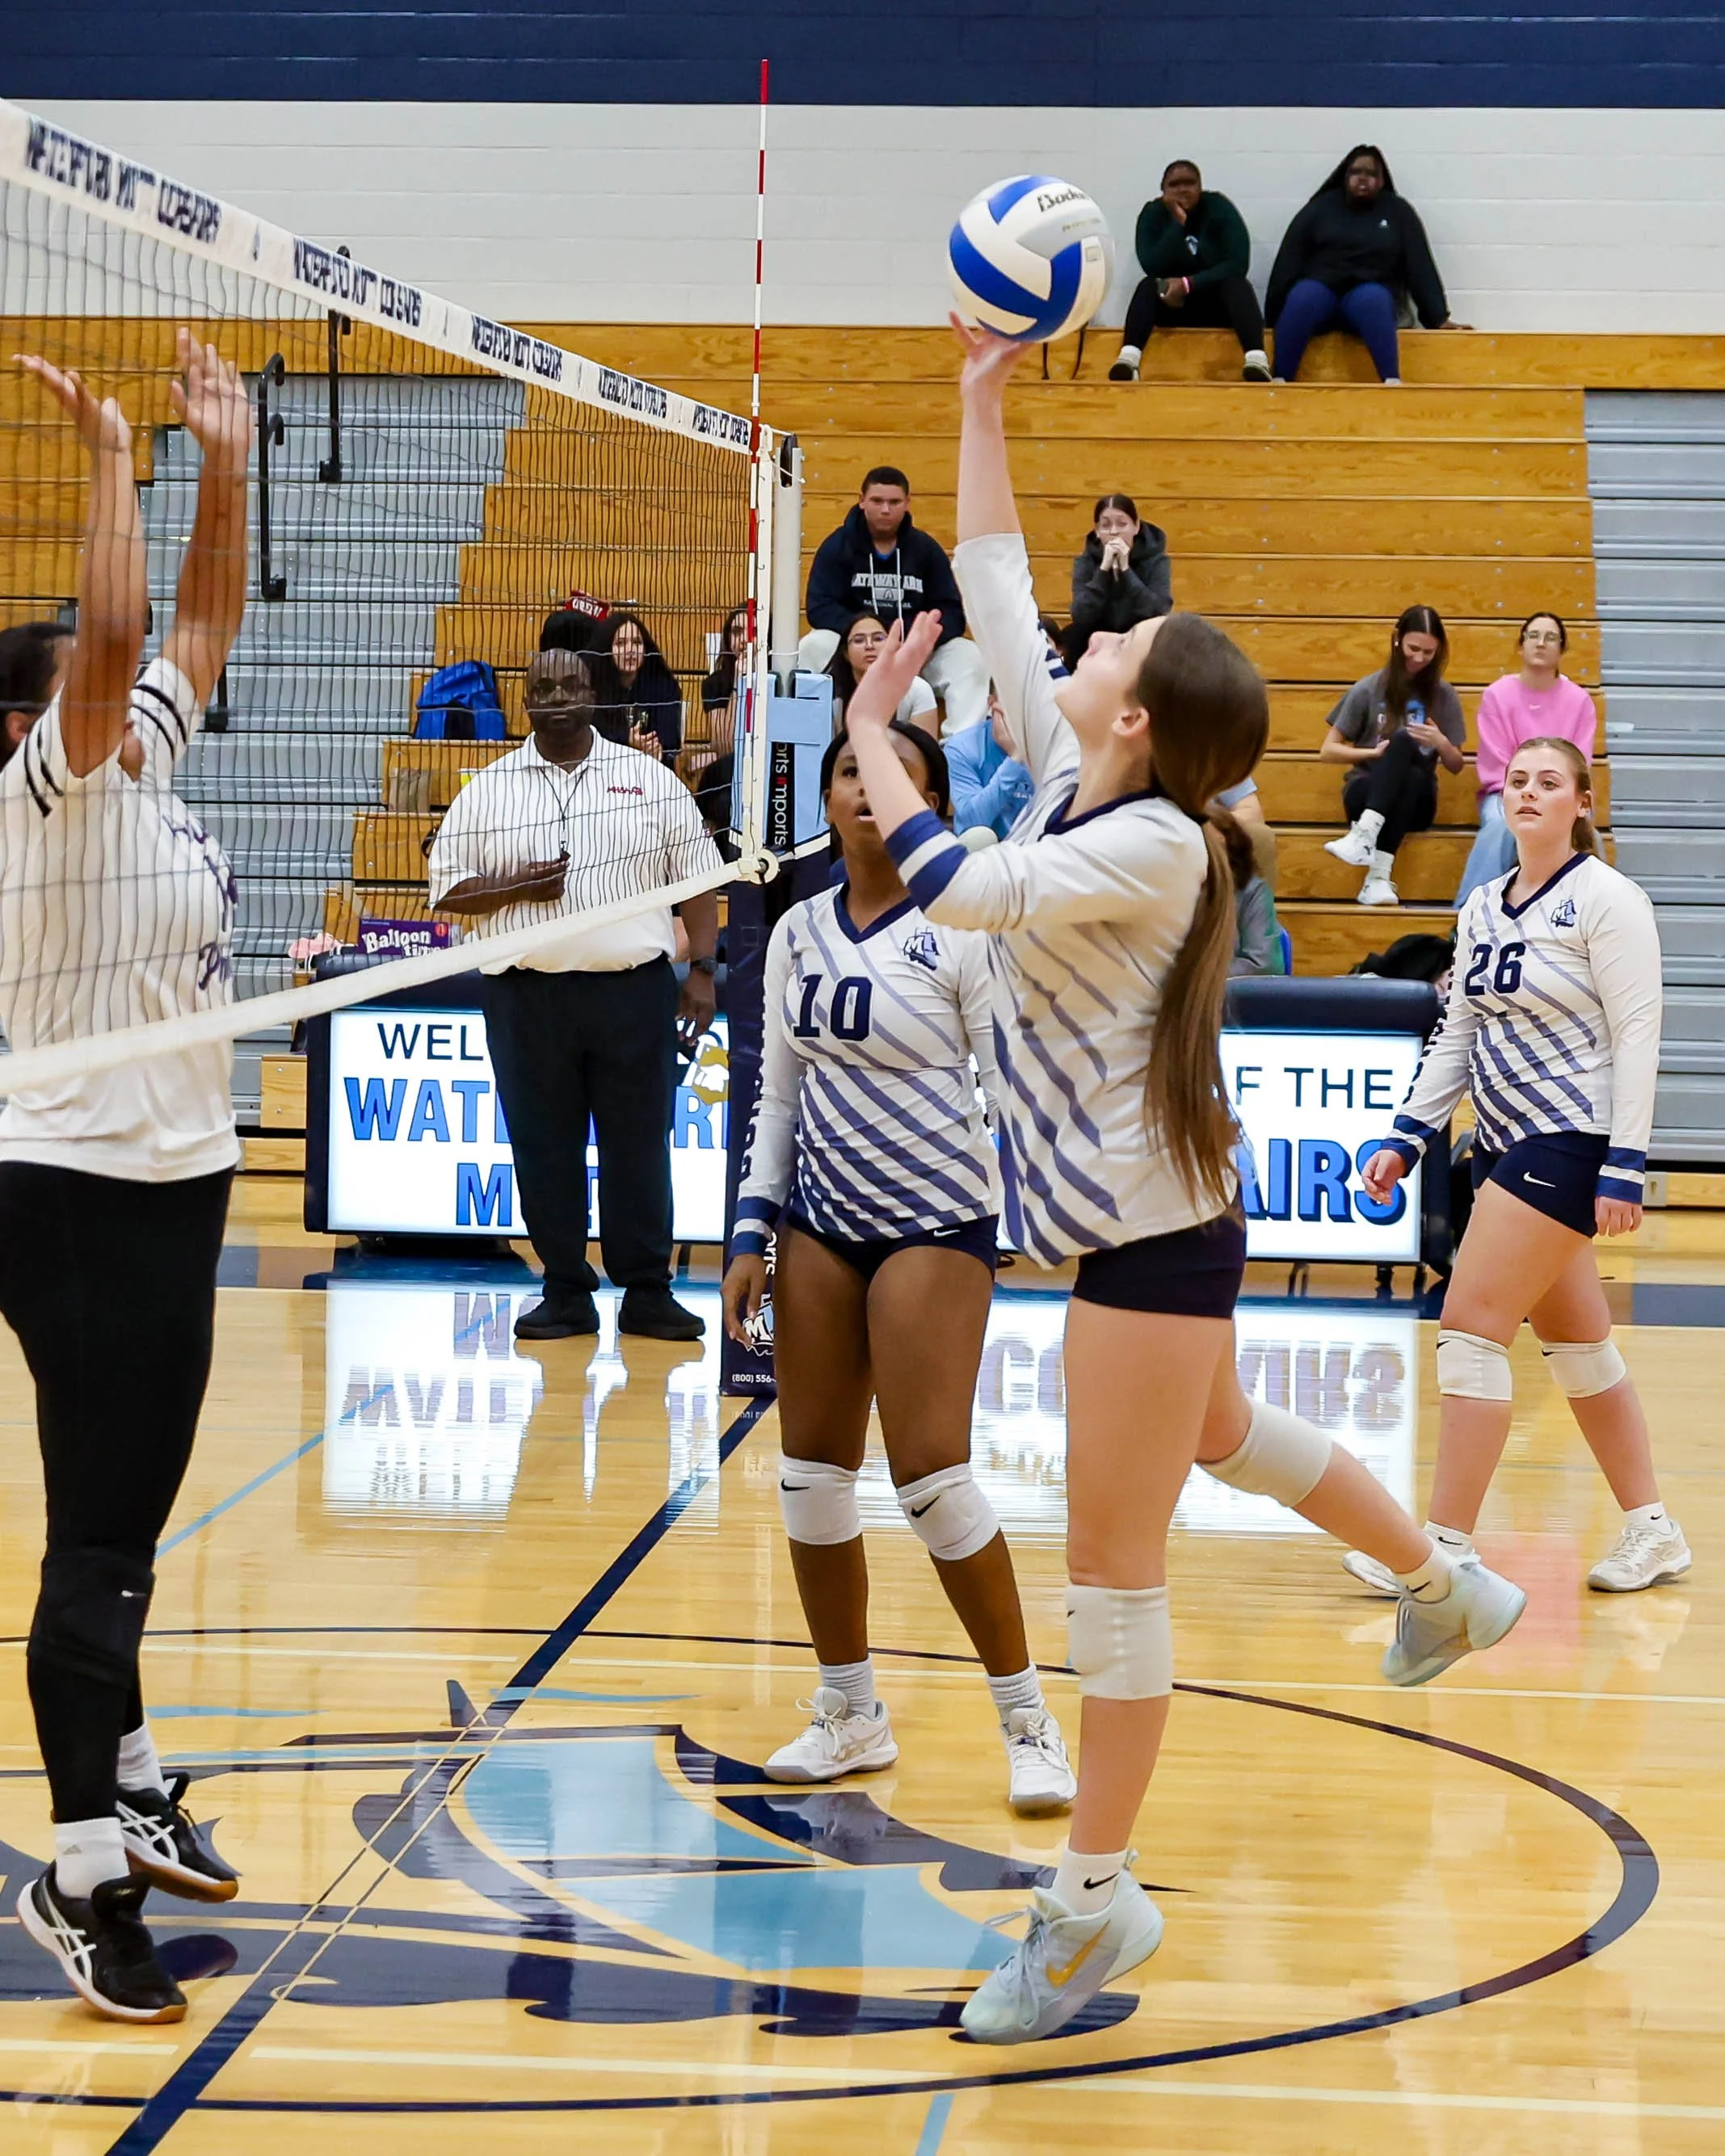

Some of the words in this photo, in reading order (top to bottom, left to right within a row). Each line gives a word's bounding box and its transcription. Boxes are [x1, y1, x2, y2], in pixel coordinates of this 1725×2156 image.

[772, 777, 789, 846] imports
[362, 929, 432, 954] Balloon
[1464, 941, 1526, 996] 26
[793, 973, 873, 1042] 10
[377, 1023, 484, 1061] WEL
[1235, 1066, 1262, 1105] F
[1284, 1067, 1394, 1109] THE
[1236, 1137, 1407, 1226] AIRS
[731, 1373, 754, 1384] (800)
[755, 1374, 777, 1383] 556-
